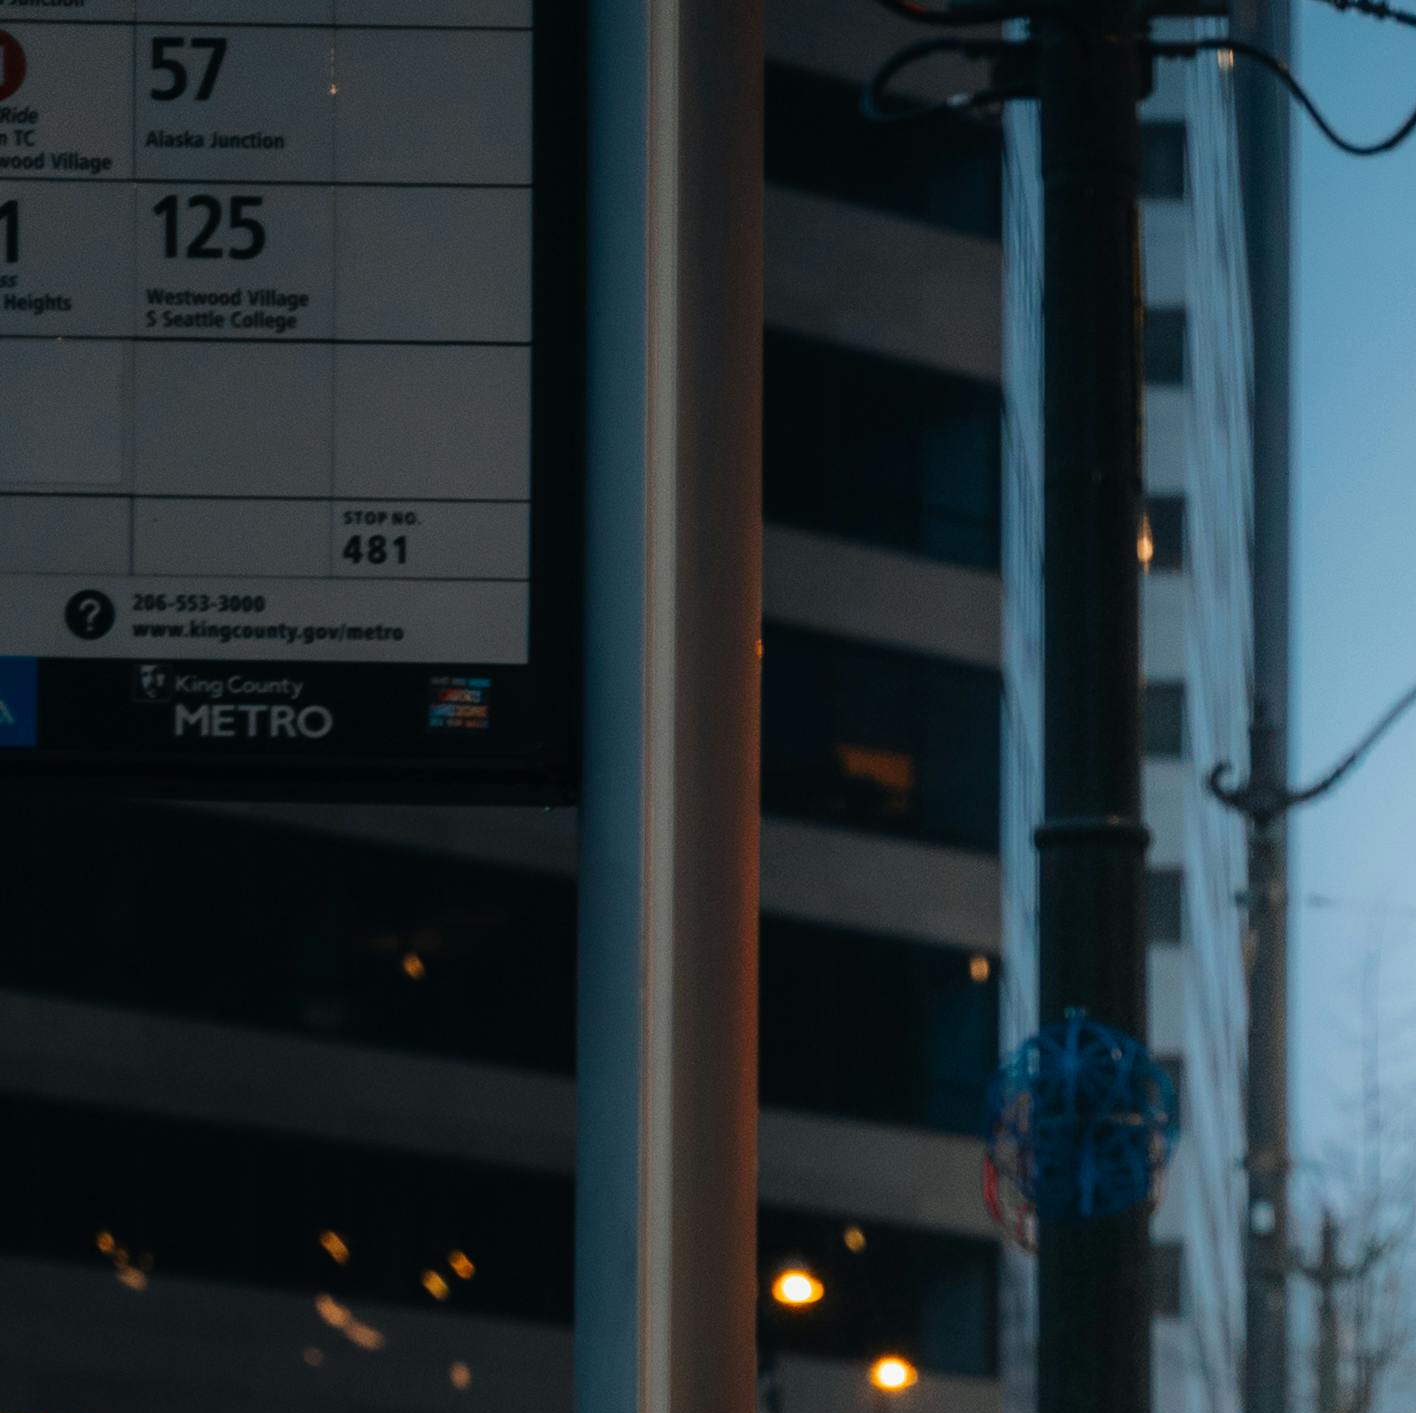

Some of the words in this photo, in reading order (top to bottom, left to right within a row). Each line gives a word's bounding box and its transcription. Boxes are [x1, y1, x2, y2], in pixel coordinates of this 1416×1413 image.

[150, 37, 228, 102] 57
[14, 129, 36, 147] TC
[145, 130, 205, 149] Alaska
[211, 131, 285, 150] Junction
[50, 151, 113, 175] Village
[153, 194, 267, 260] 125
[4, 293, 72, 315] Heights
[145, 289, 242, 307] Westwood
[247, 289, 310, 311] Village
[145, 310, 157, 328] S
[163, 310, 225, 329] Seattle
[230, 311, 298, 333] College
[343, 510, 387, 526] STOP
[391, 511, 422, 527] NO.
[343, 534, 408, 565] 481
[132, 593, 266, 613] 206-553-3000
[132, 620, 405, 645] www.kingcounty.gov/metro
[175, 674, 223, 698] King
[227, 675, 304, 699] County
[175, 704, 334, 739] METRO
